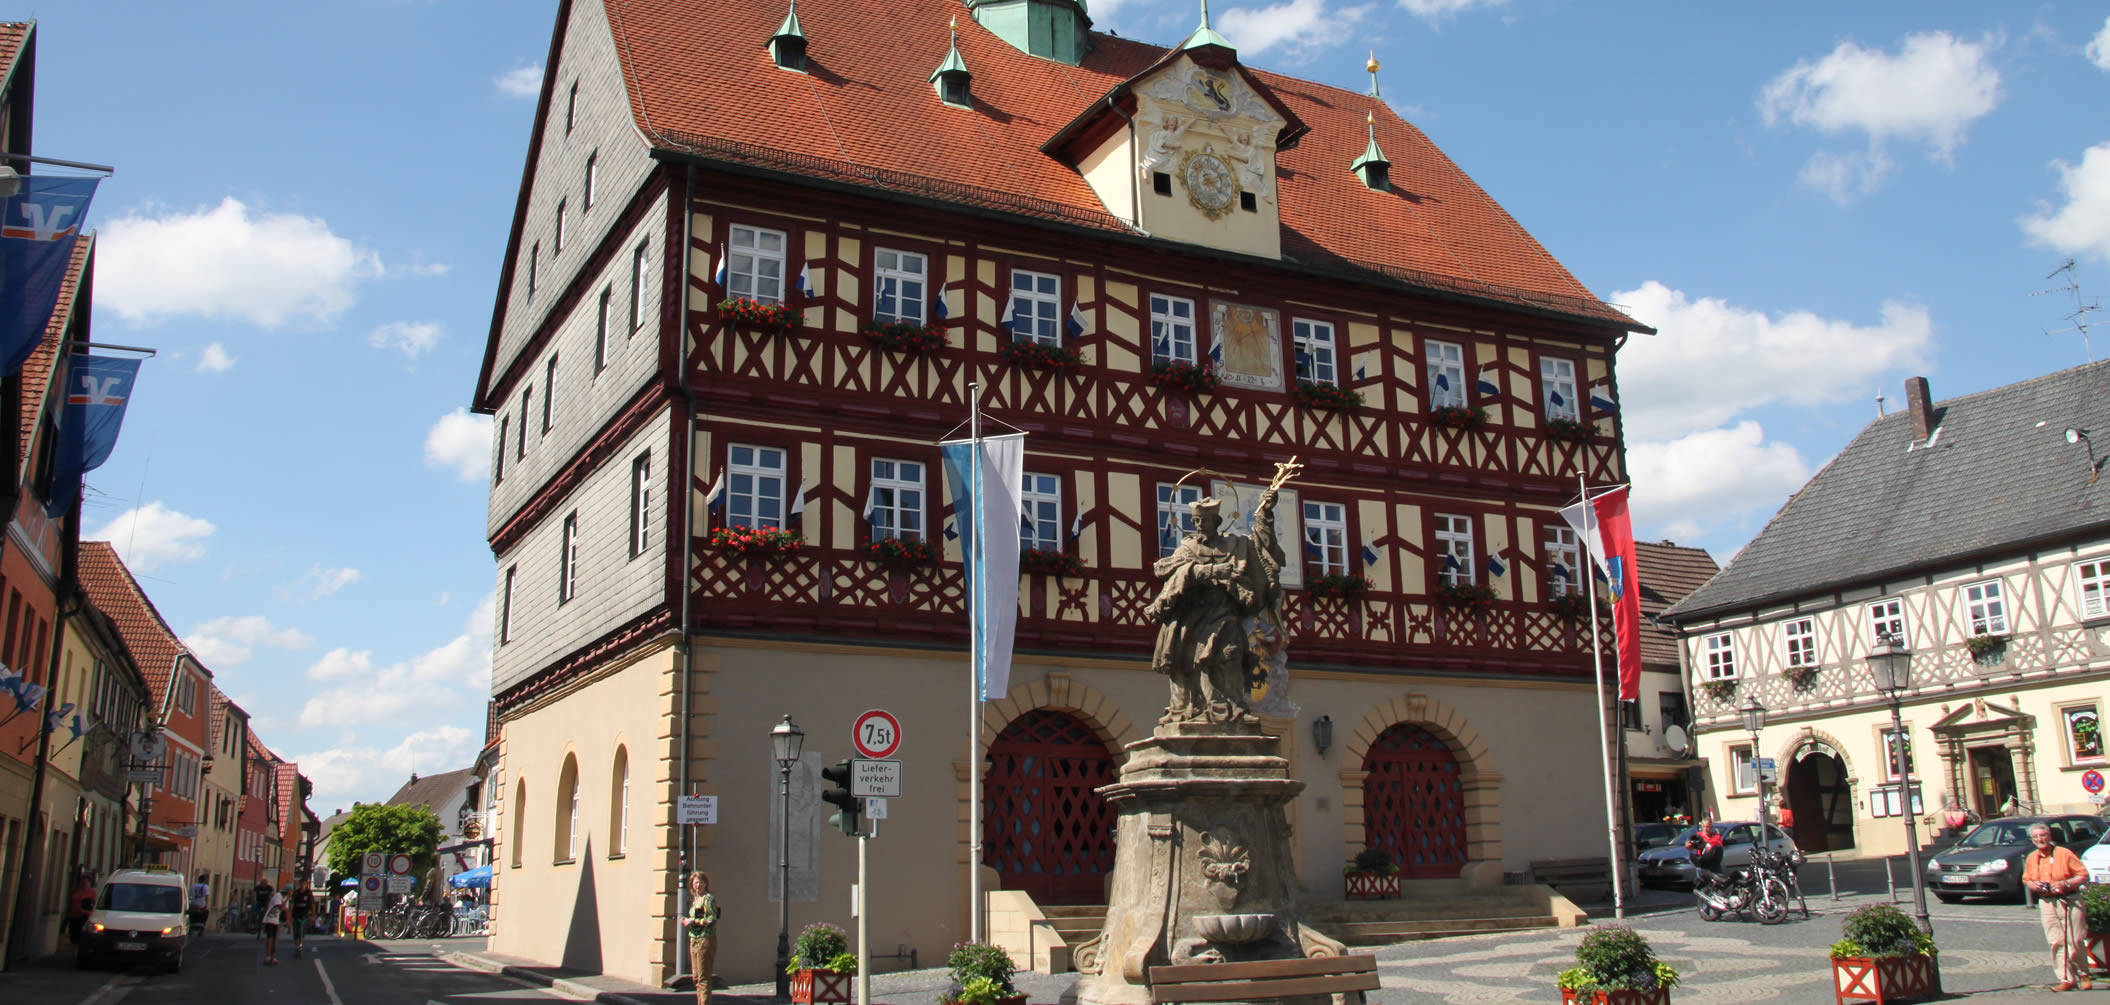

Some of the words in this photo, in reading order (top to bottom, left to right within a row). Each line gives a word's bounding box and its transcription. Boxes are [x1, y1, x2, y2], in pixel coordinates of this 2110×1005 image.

[862, 764, 892, 773] Liefer-
[860, 775, 894, 783] verkehr
[869, 785, 885, 793] frei
